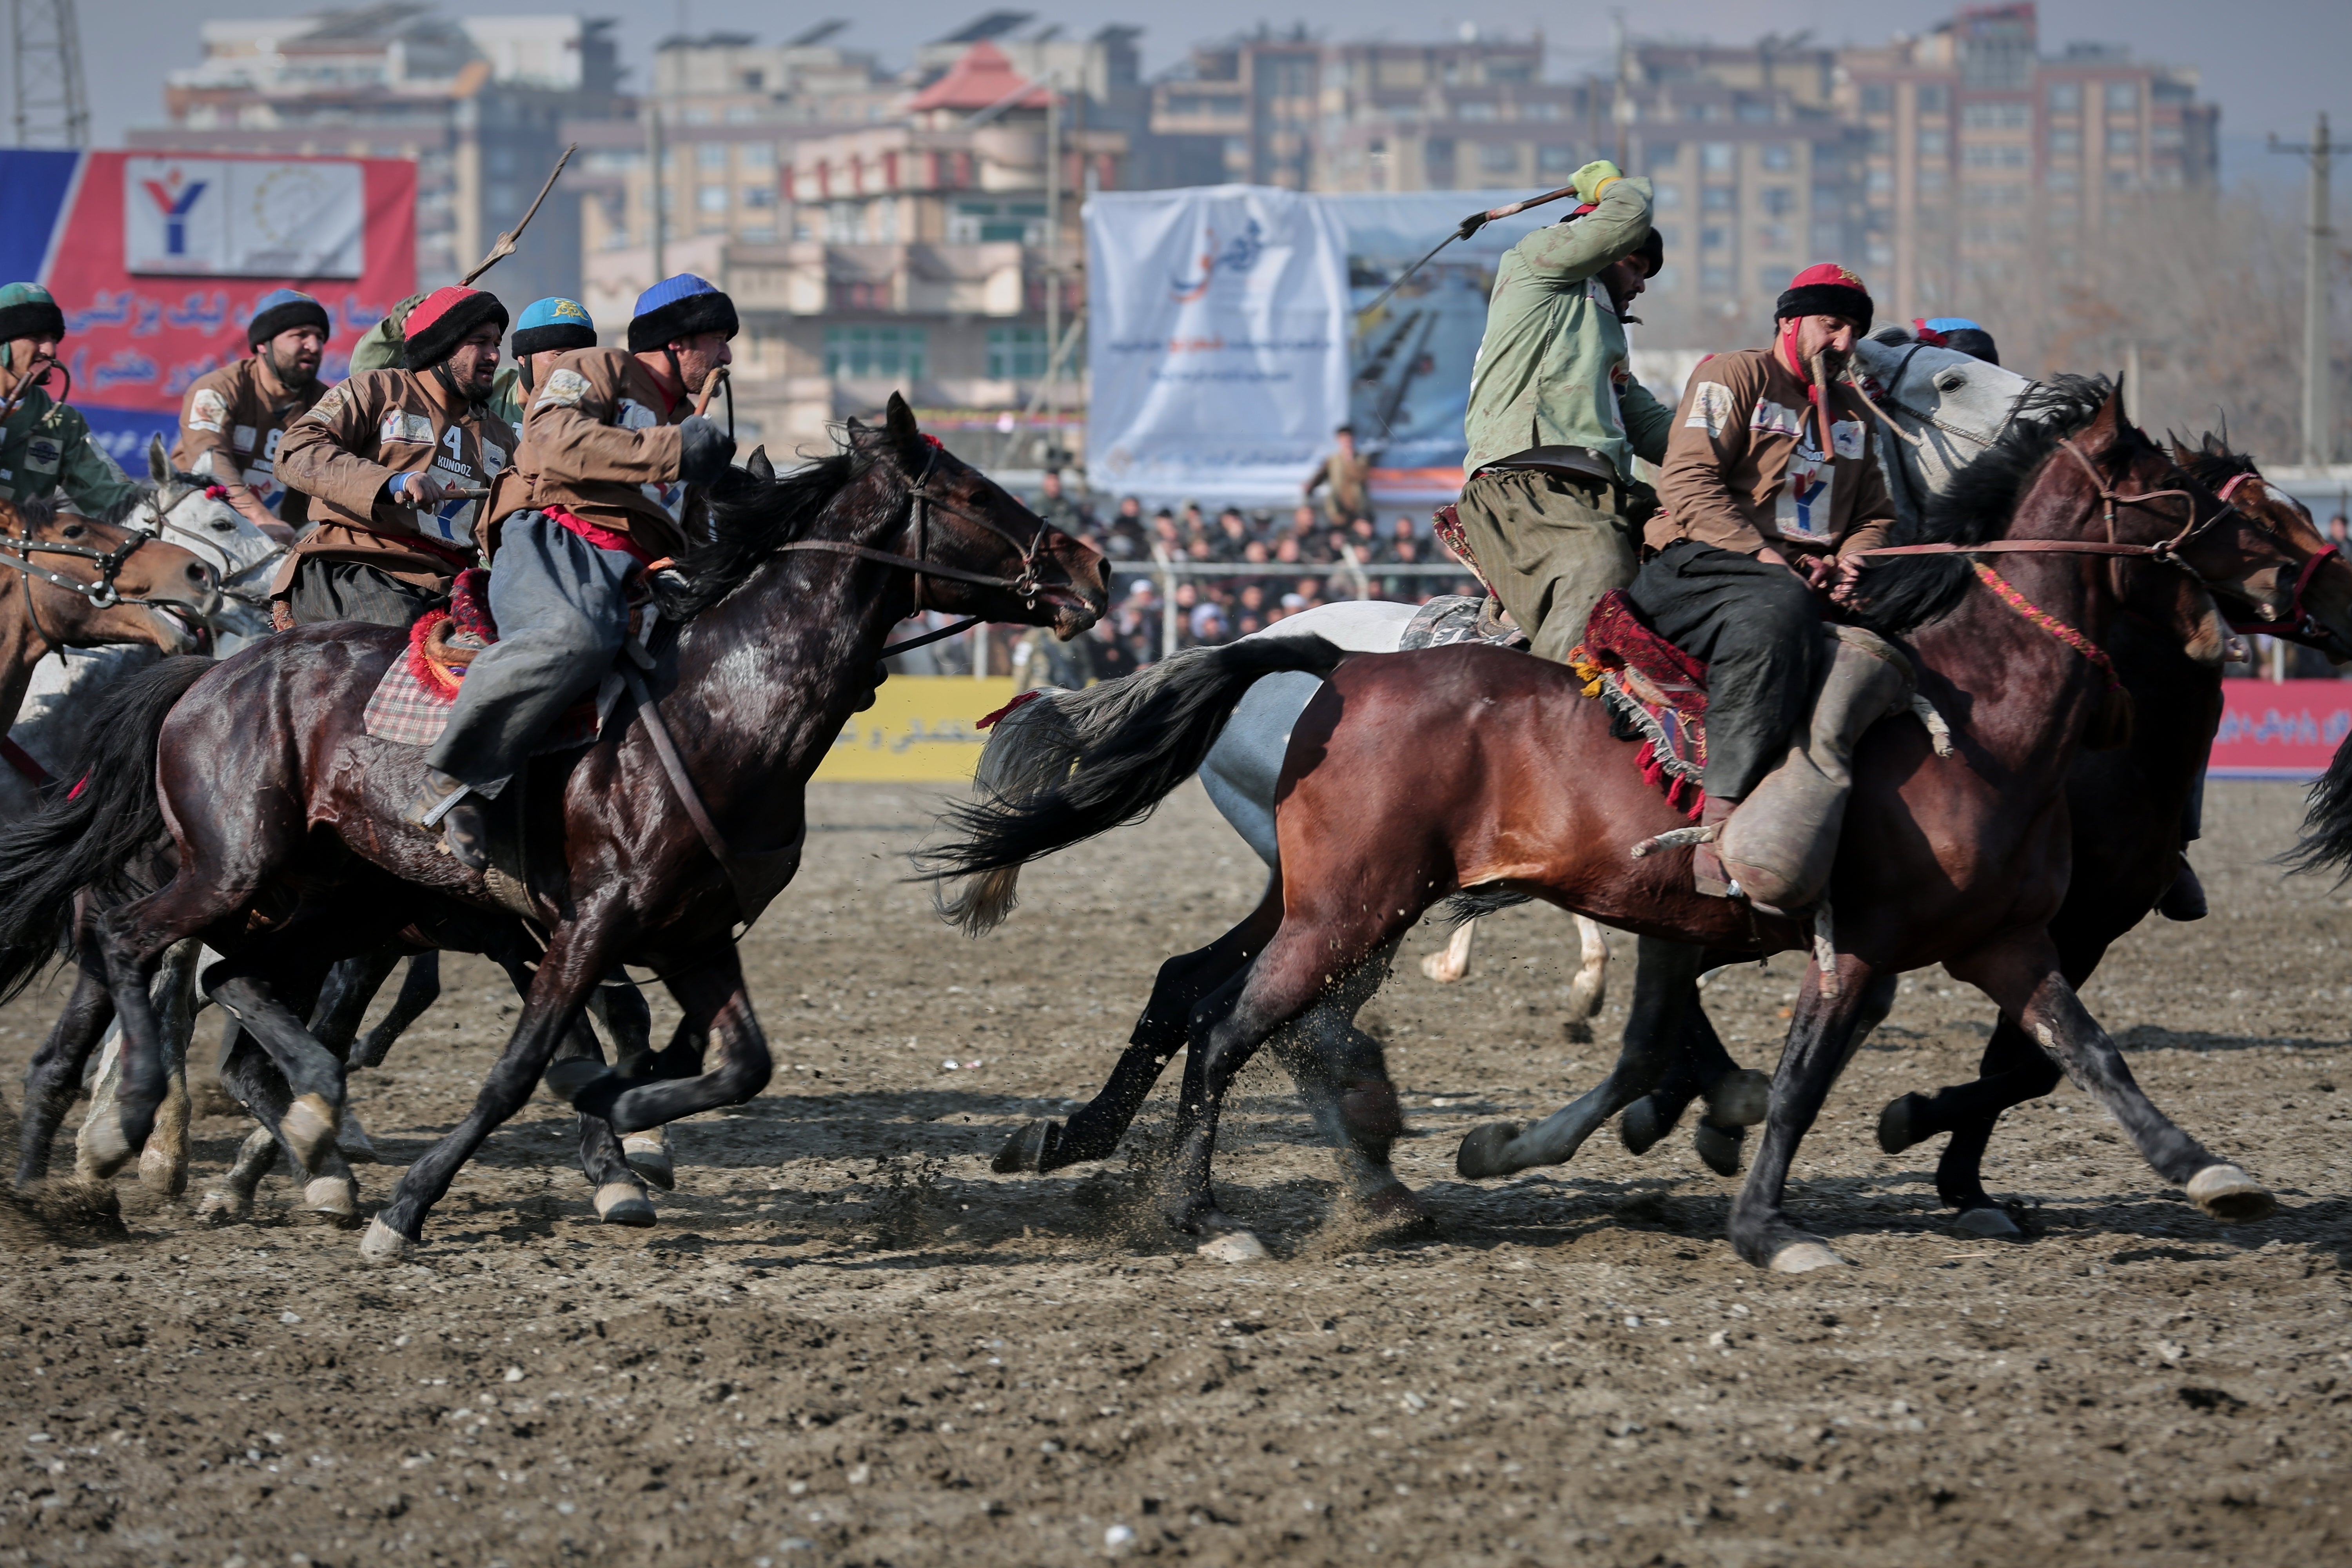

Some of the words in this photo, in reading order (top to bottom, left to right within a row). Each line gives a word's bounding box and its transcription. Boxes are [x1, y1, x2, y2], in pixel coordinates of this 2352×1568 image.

[263, 428, 284, 461] 8
[442, 425, 461, 461] 4
[437, 455, 471, 477] KUNDOZ
